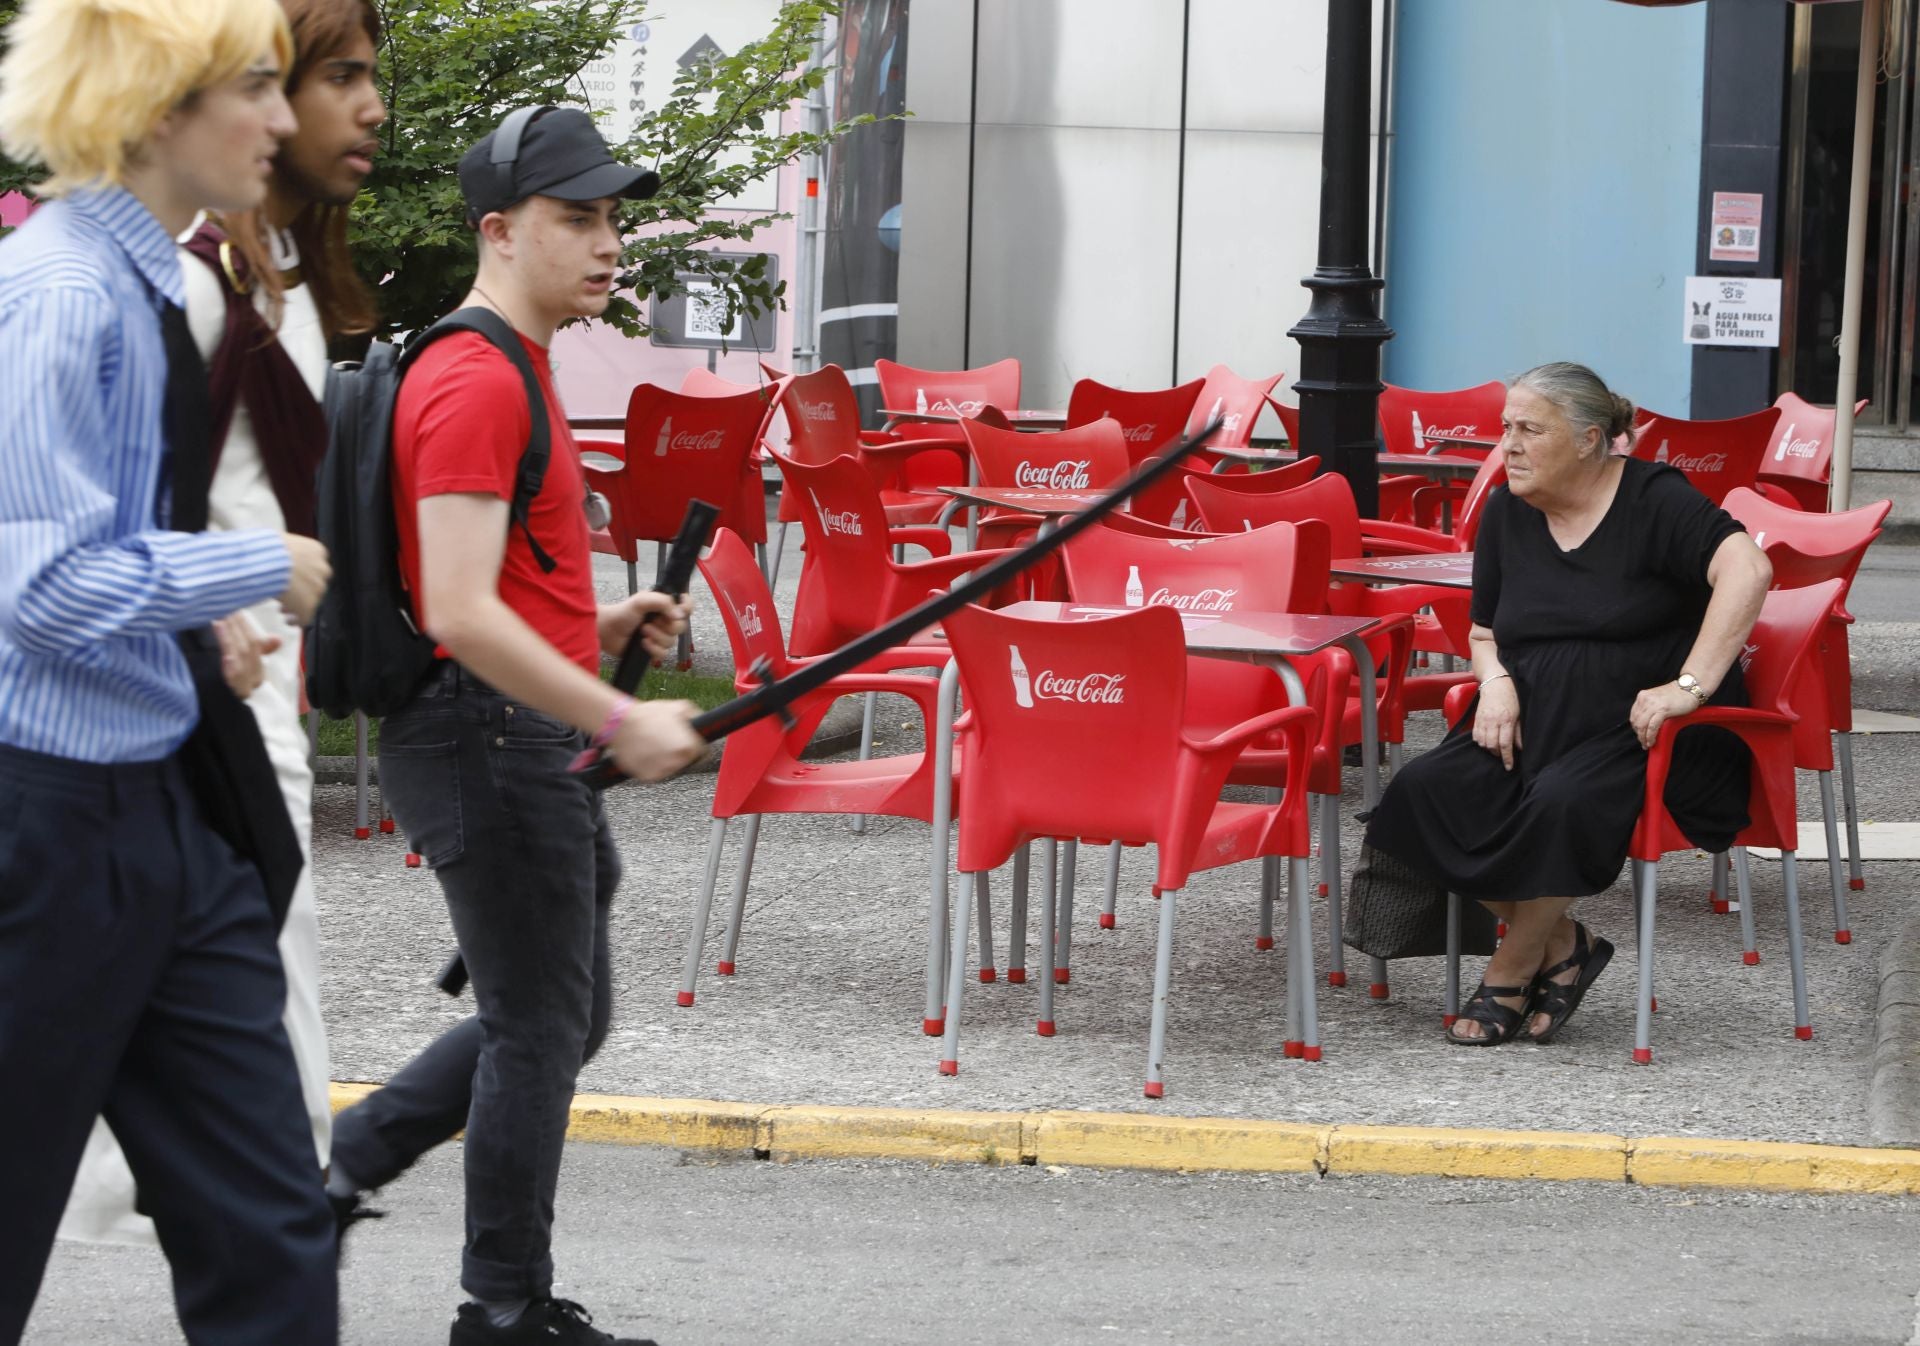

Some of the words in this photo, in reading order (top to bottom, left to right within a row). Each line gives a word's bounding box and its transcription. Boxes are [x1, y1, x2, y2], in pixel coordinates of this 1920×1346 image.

[1716, 312, 1739, 320] AGUA
[1742, 313, 1773, 321] FRESCA
[1715, 321, 1738, 329] PARA
[1715, 329, 1726, 337] TU
[1728, 330, 1764, 338] PERRETE
[1015, 460, 1090, 490] Coca-Cola
[1034, 669, 1127, 704] Coca-Cola
